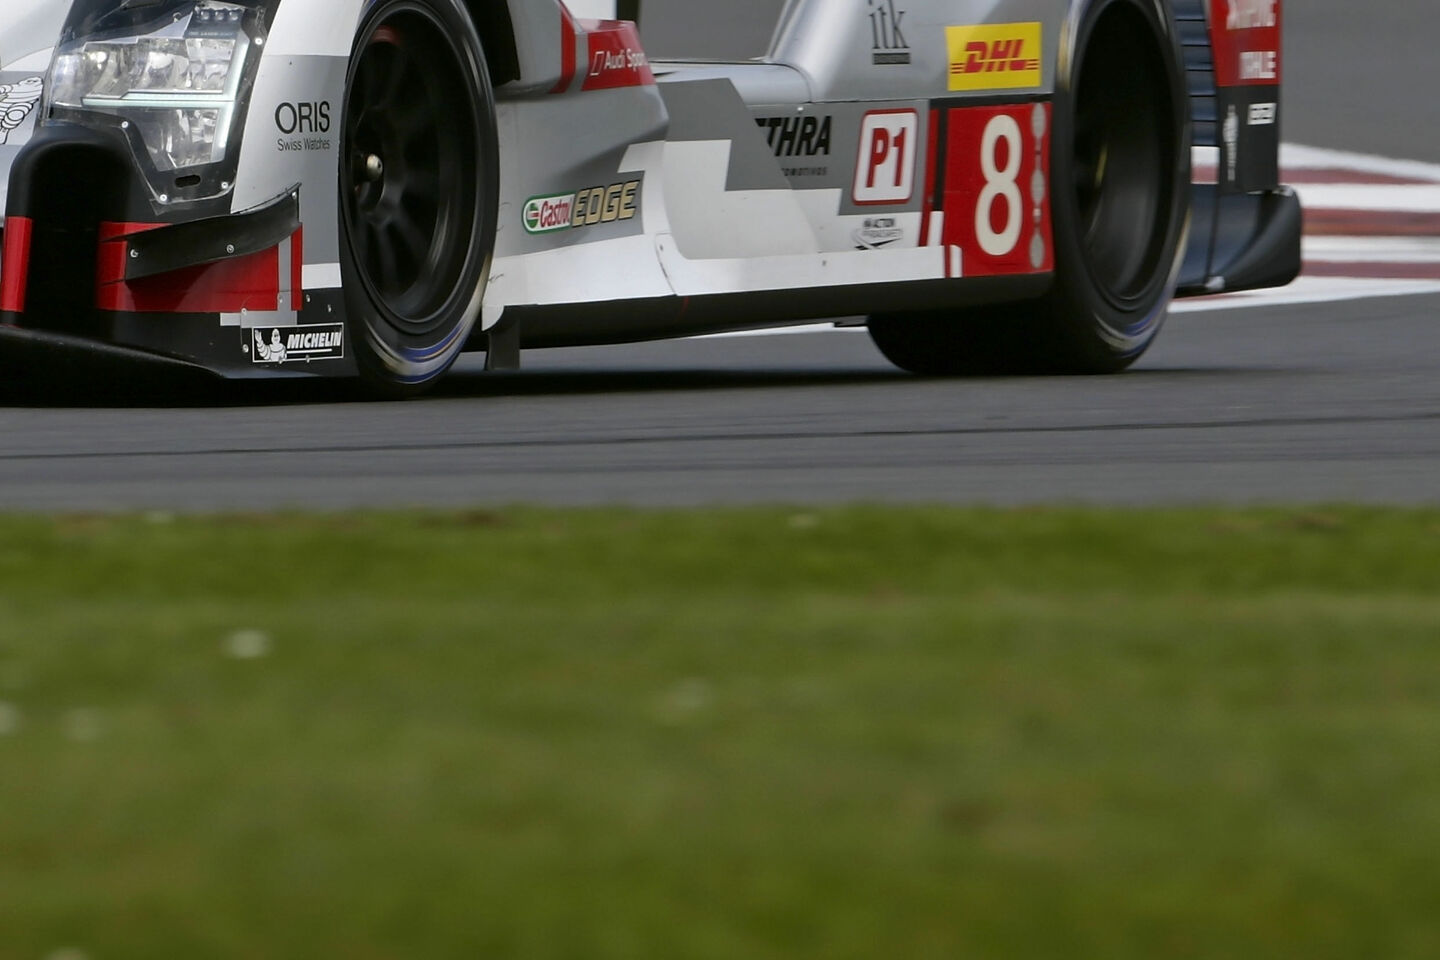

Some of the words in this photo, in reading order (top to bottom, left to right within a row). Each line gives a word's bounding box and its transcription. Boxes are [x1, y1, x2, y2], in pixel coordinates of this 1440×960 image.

[604, 50, 626, 70] Audi
[963, 38, 1027, 74] DHL
[274, 100, 331, 135] ORIS
[277, 138, 302, 151] Swiss
[866, 126, 907, 188] P1
[975, 114, 1023, 256] 8
[540, 197, 573, 228] Castrol
[571, 180, 641, 228] EDGE
[286, 332, 342, 350] MICHELIN
